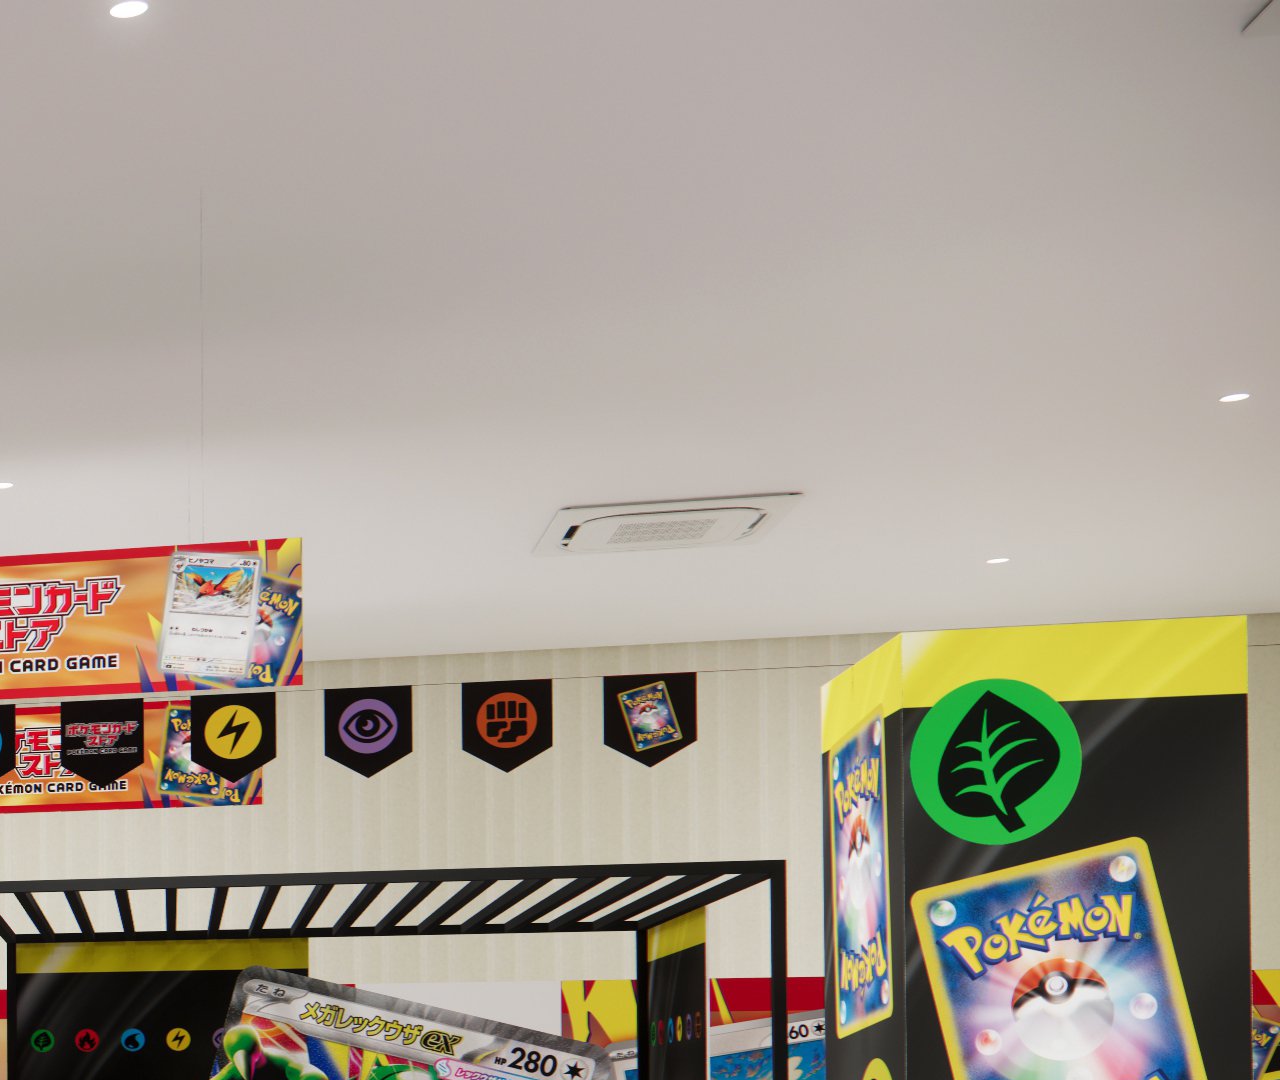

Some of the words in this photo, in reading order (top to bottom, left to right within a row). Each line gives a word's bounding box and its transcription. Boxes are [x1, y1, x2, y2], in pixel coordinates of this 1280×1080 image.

[10, 657, 61, 674] CARD
[67, 654, 119, 671] GAME
[65, 721, 139, 737] ポケモンカード
[83, 735, 120, 748] ストア
[17, 754, 74, 778] スト
[47, 782, 84, 793] CARD
[299, 1002, 463, 1055] メガレックウザex
[789, 1024, 809, 1039] 60
[494, 1056, 506, 1065] HP
[508, 1047, 558, 1077] 280
